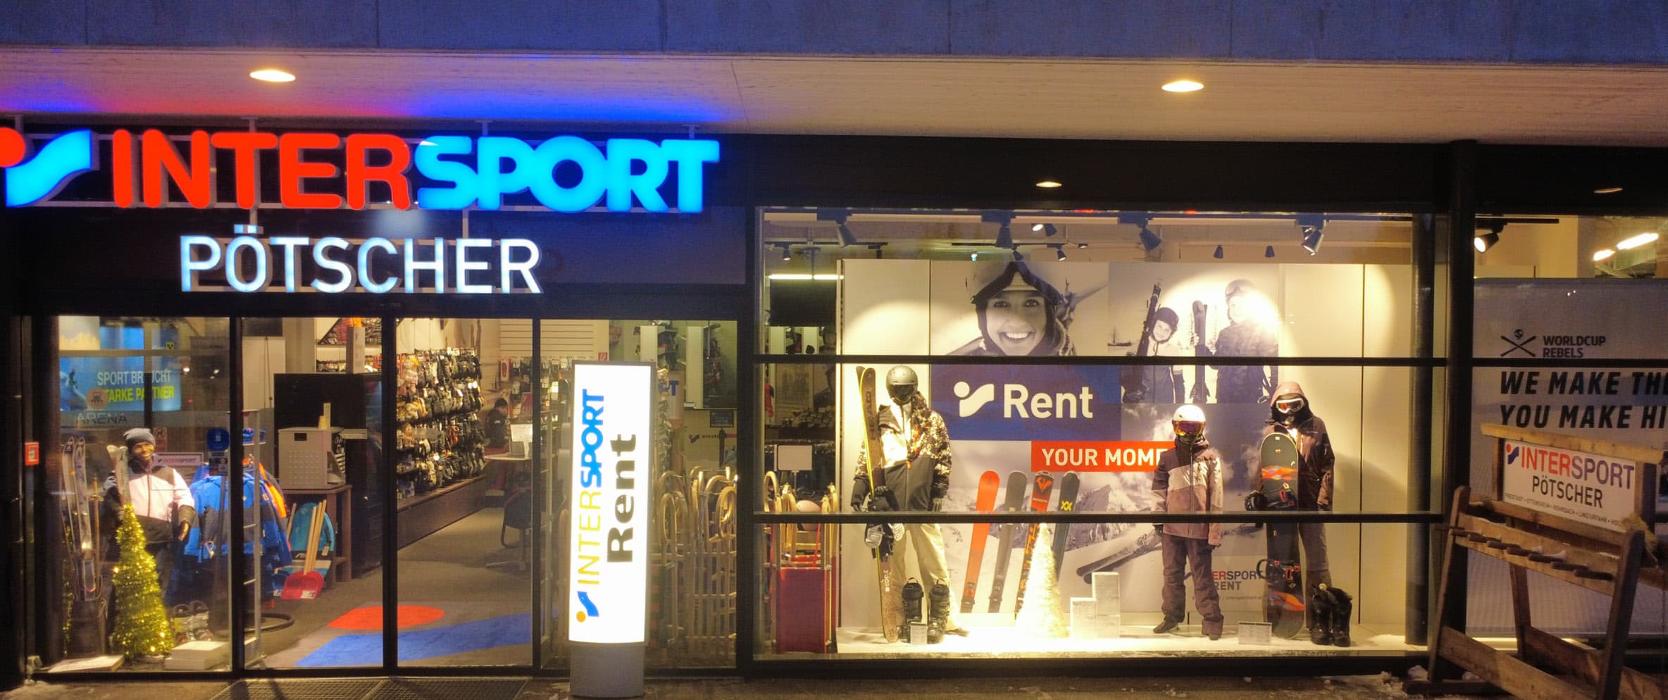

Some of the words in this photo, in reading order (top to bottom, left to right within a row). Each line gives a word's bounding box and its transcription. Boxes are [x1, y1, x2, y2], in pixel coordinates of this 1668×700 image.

[111, 129, 720, 213] INTERSPORT
[180, 224, 542, 294] PÖTSCHER
[1543, 335, 1606, 346] WORLDCUP
[1543, 348, 1584, 358] REBELS
[97, 370, 129, 386] SPORT
[131, 369, 171, 385] BRCHT
[1500, 371, 1540, 395] WE
[1547, 371, 1621, 395] MAKE
[105, 387, 134, 403] TARKE
[136, 385, 175, 401] PATNER
[1003, 383, 1094, 419] Rent
[1500, 404, 1550, 428] YOU
[1559, 405, 1632, 429] MAKE
[1042, 448, 1098, 467] YOUR
[1521, 446, 1635, 489] INTERSPORT
[577, 388, 605, 585] INTERSPORT
[606, 433, 637, 563] Rent
[1532, 475, 1603, 508] PÖTSCHER
